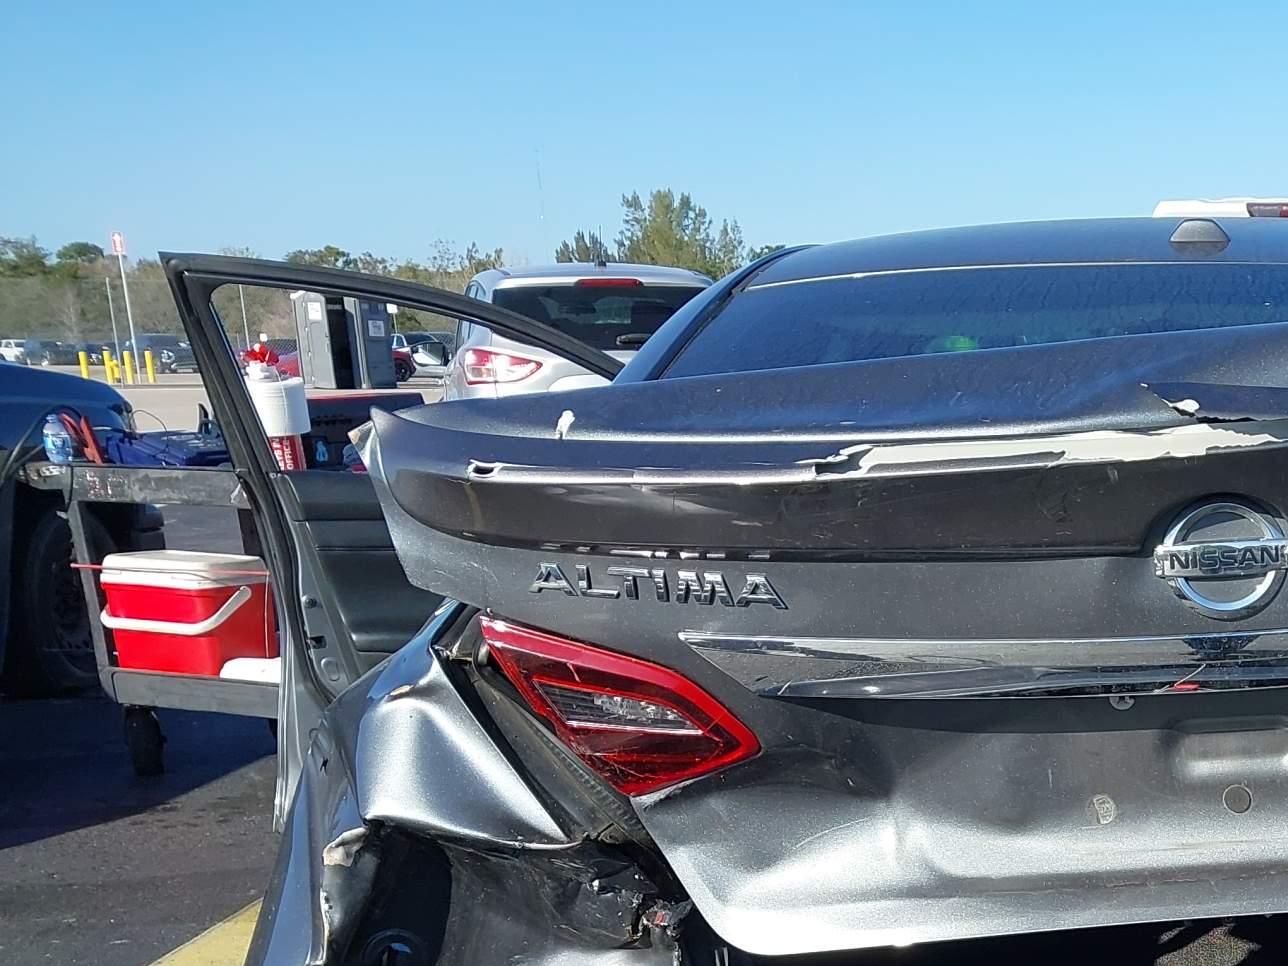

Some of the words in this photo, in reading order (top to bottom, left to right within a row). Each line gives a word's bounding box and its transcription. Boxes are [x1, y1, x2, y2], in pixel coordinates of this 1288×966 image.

[283, 439, 294, 470] OFFICE
[1168, 545, 1281, 571] NISSAN
[528, 561, 789, 610] ALTIMA
